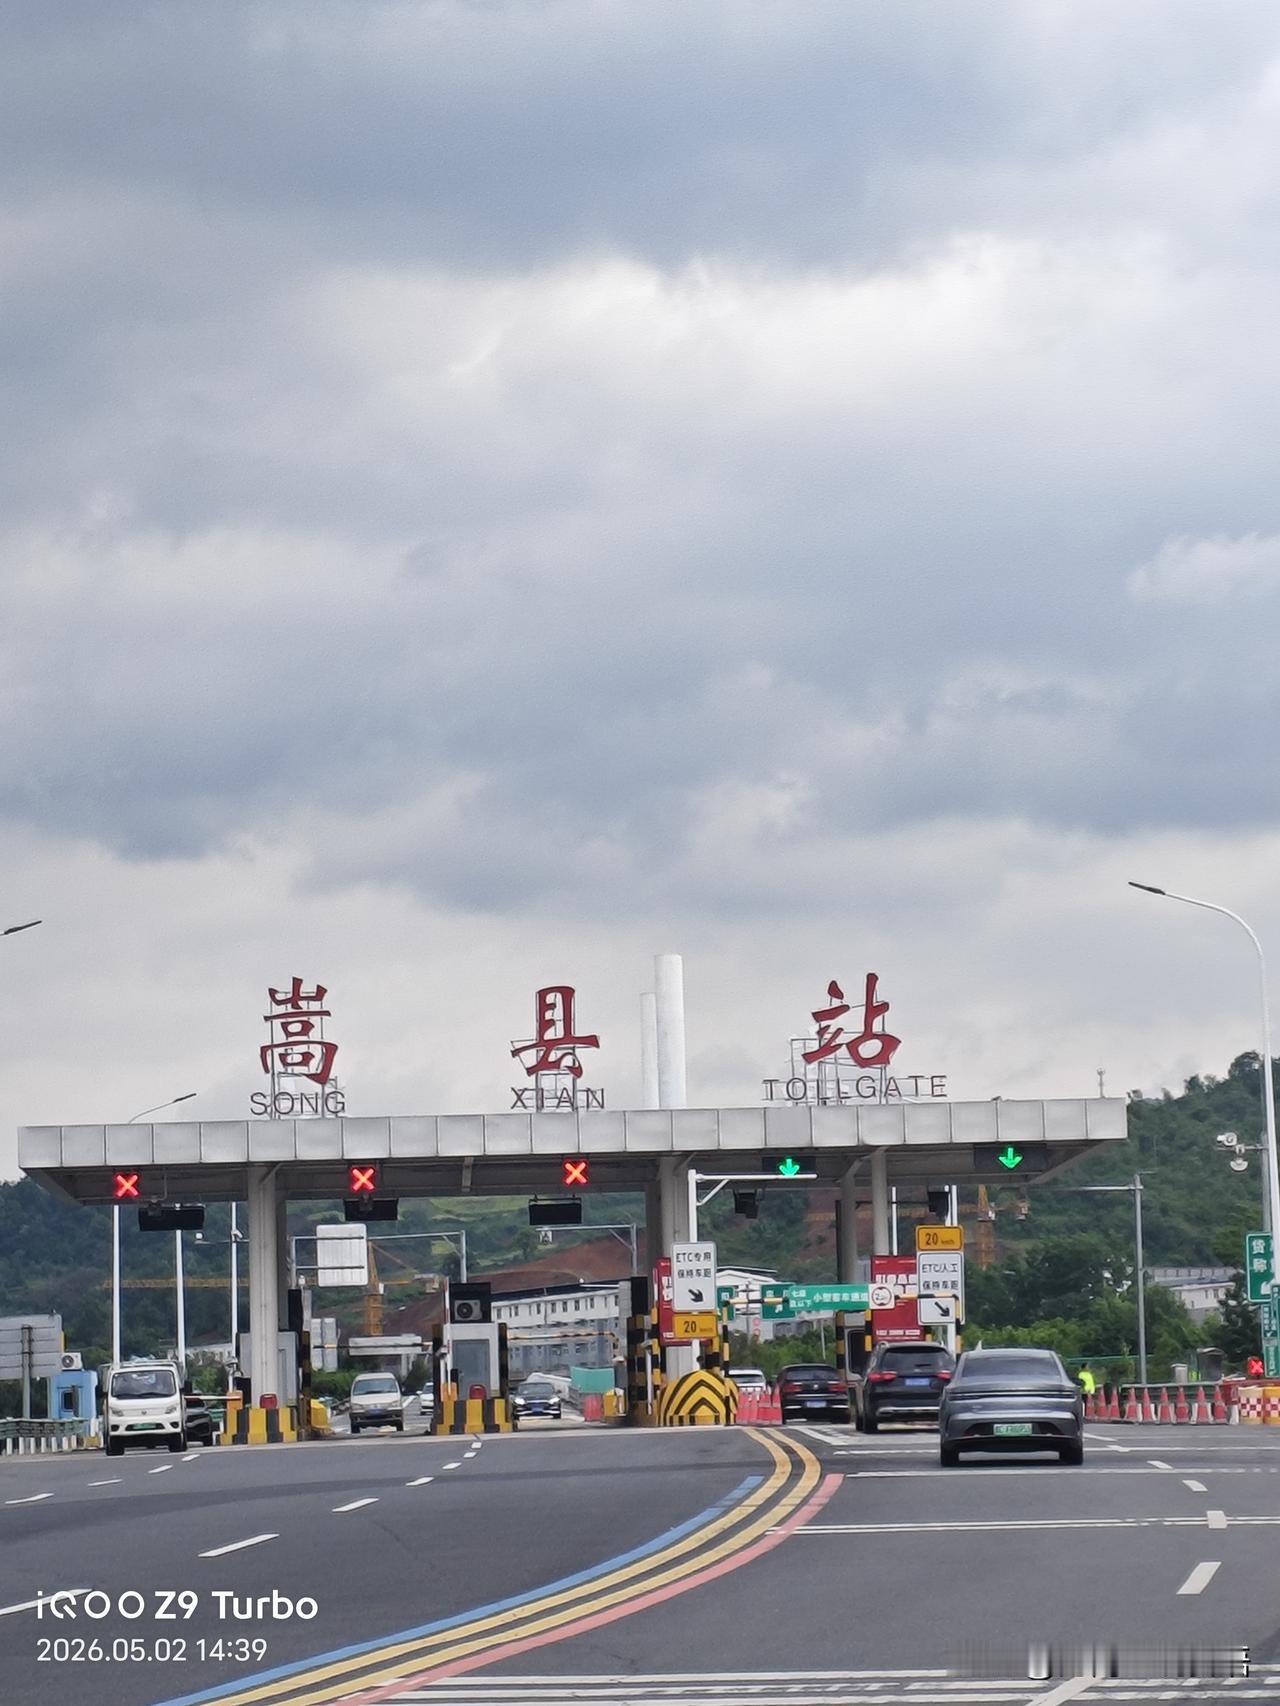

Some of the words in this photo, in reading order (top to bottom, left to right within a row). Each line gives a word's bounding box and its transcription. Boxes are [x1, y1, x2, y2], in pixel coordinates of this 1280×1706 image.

[260, 976, 339, 1085] 嵩
[511, 986, 600, 1079] 县
[801, 973, 902, 1068] 站
[250, 1091, 346, 1116] SONG
[511, 1087, 606, 1109] XIAN
[763, 1074, 947, 1101] TOLLGATE
[925, 1233, 939, 1246] 20
[683, 1320, 697, 1333] 20
